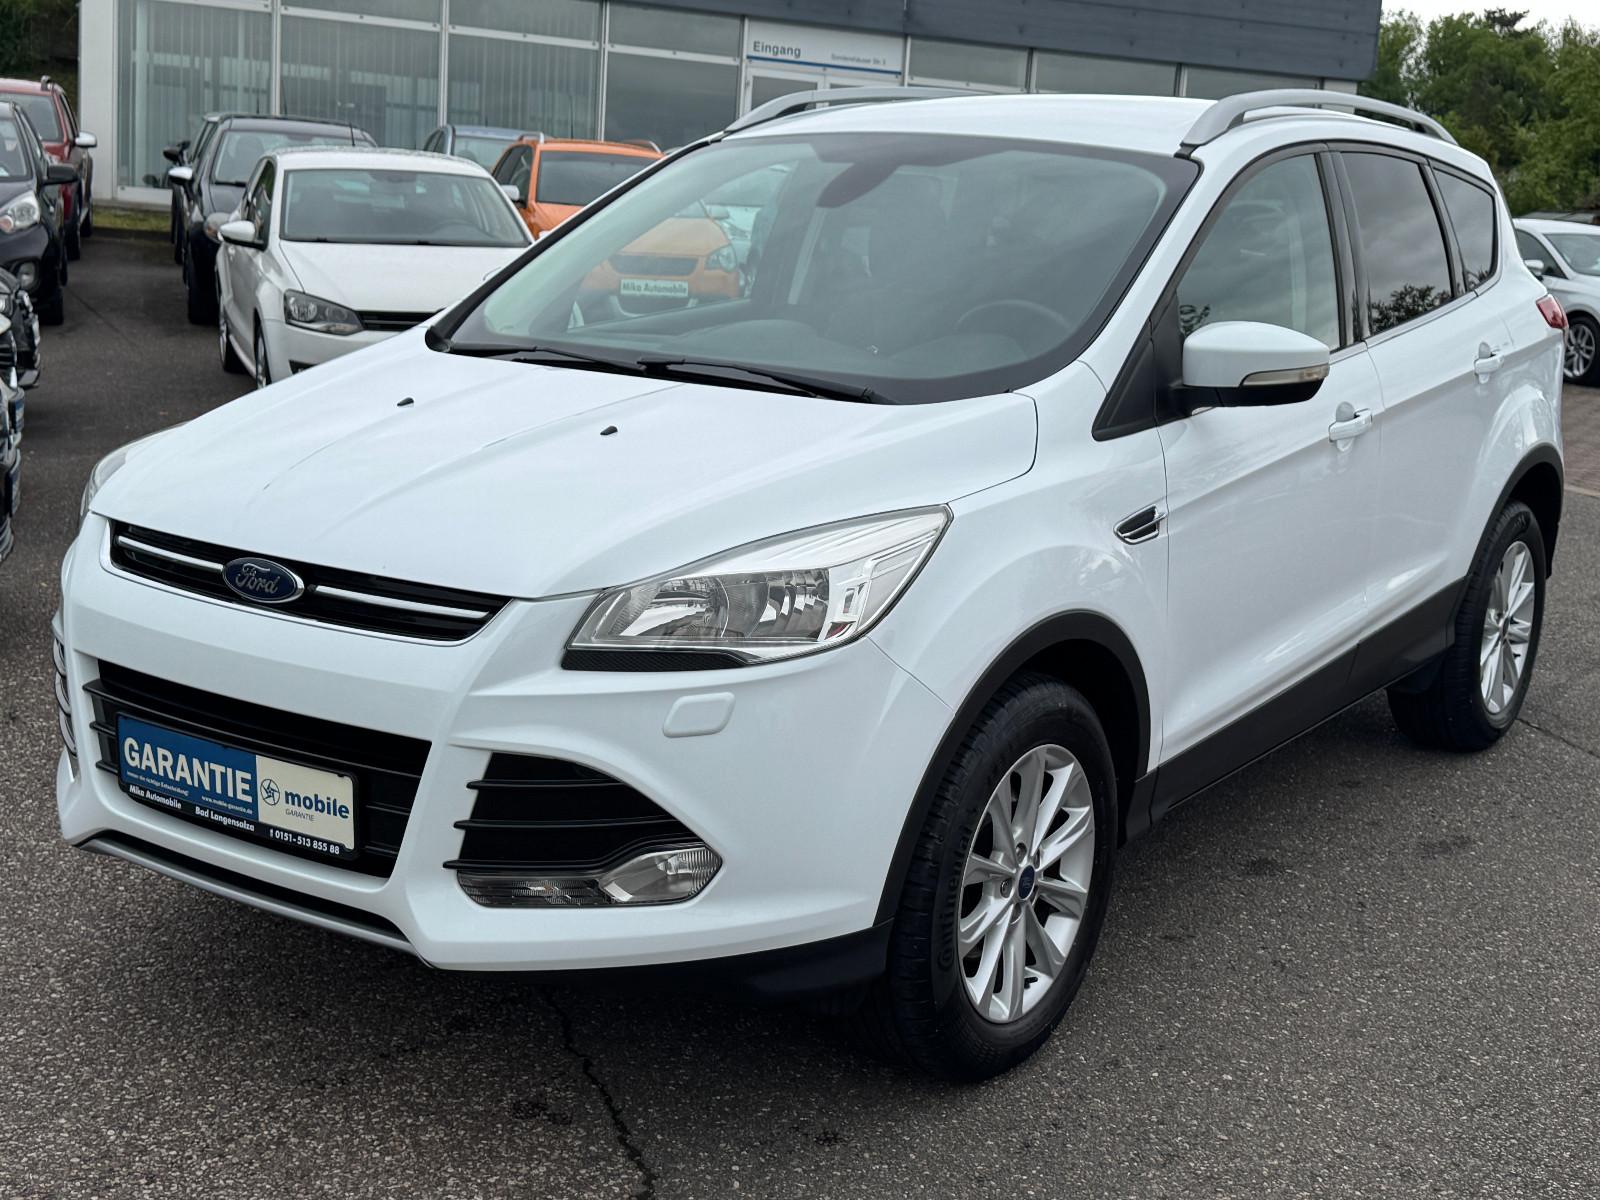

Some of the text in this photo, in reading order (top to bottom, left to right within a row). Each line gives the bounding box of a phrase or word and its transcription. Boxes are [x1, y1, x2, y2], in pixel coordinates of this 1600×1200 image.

[753, 41, 801, 59] Eingang
[622, 282, 687, 295] Mika Automobile
[235, 563, 281, 594] Ford
[124, 737, 253, 803] GARANTIE
[129, 785, 182, 809] Mika Automobile
[284, 790, 350, 820] mobile
[195, 805, 255, 832] Bad Langensalza
[285, 808, 316, 822] GARANTIE
[275, 830, 341, 855] 0151-513 855 88
